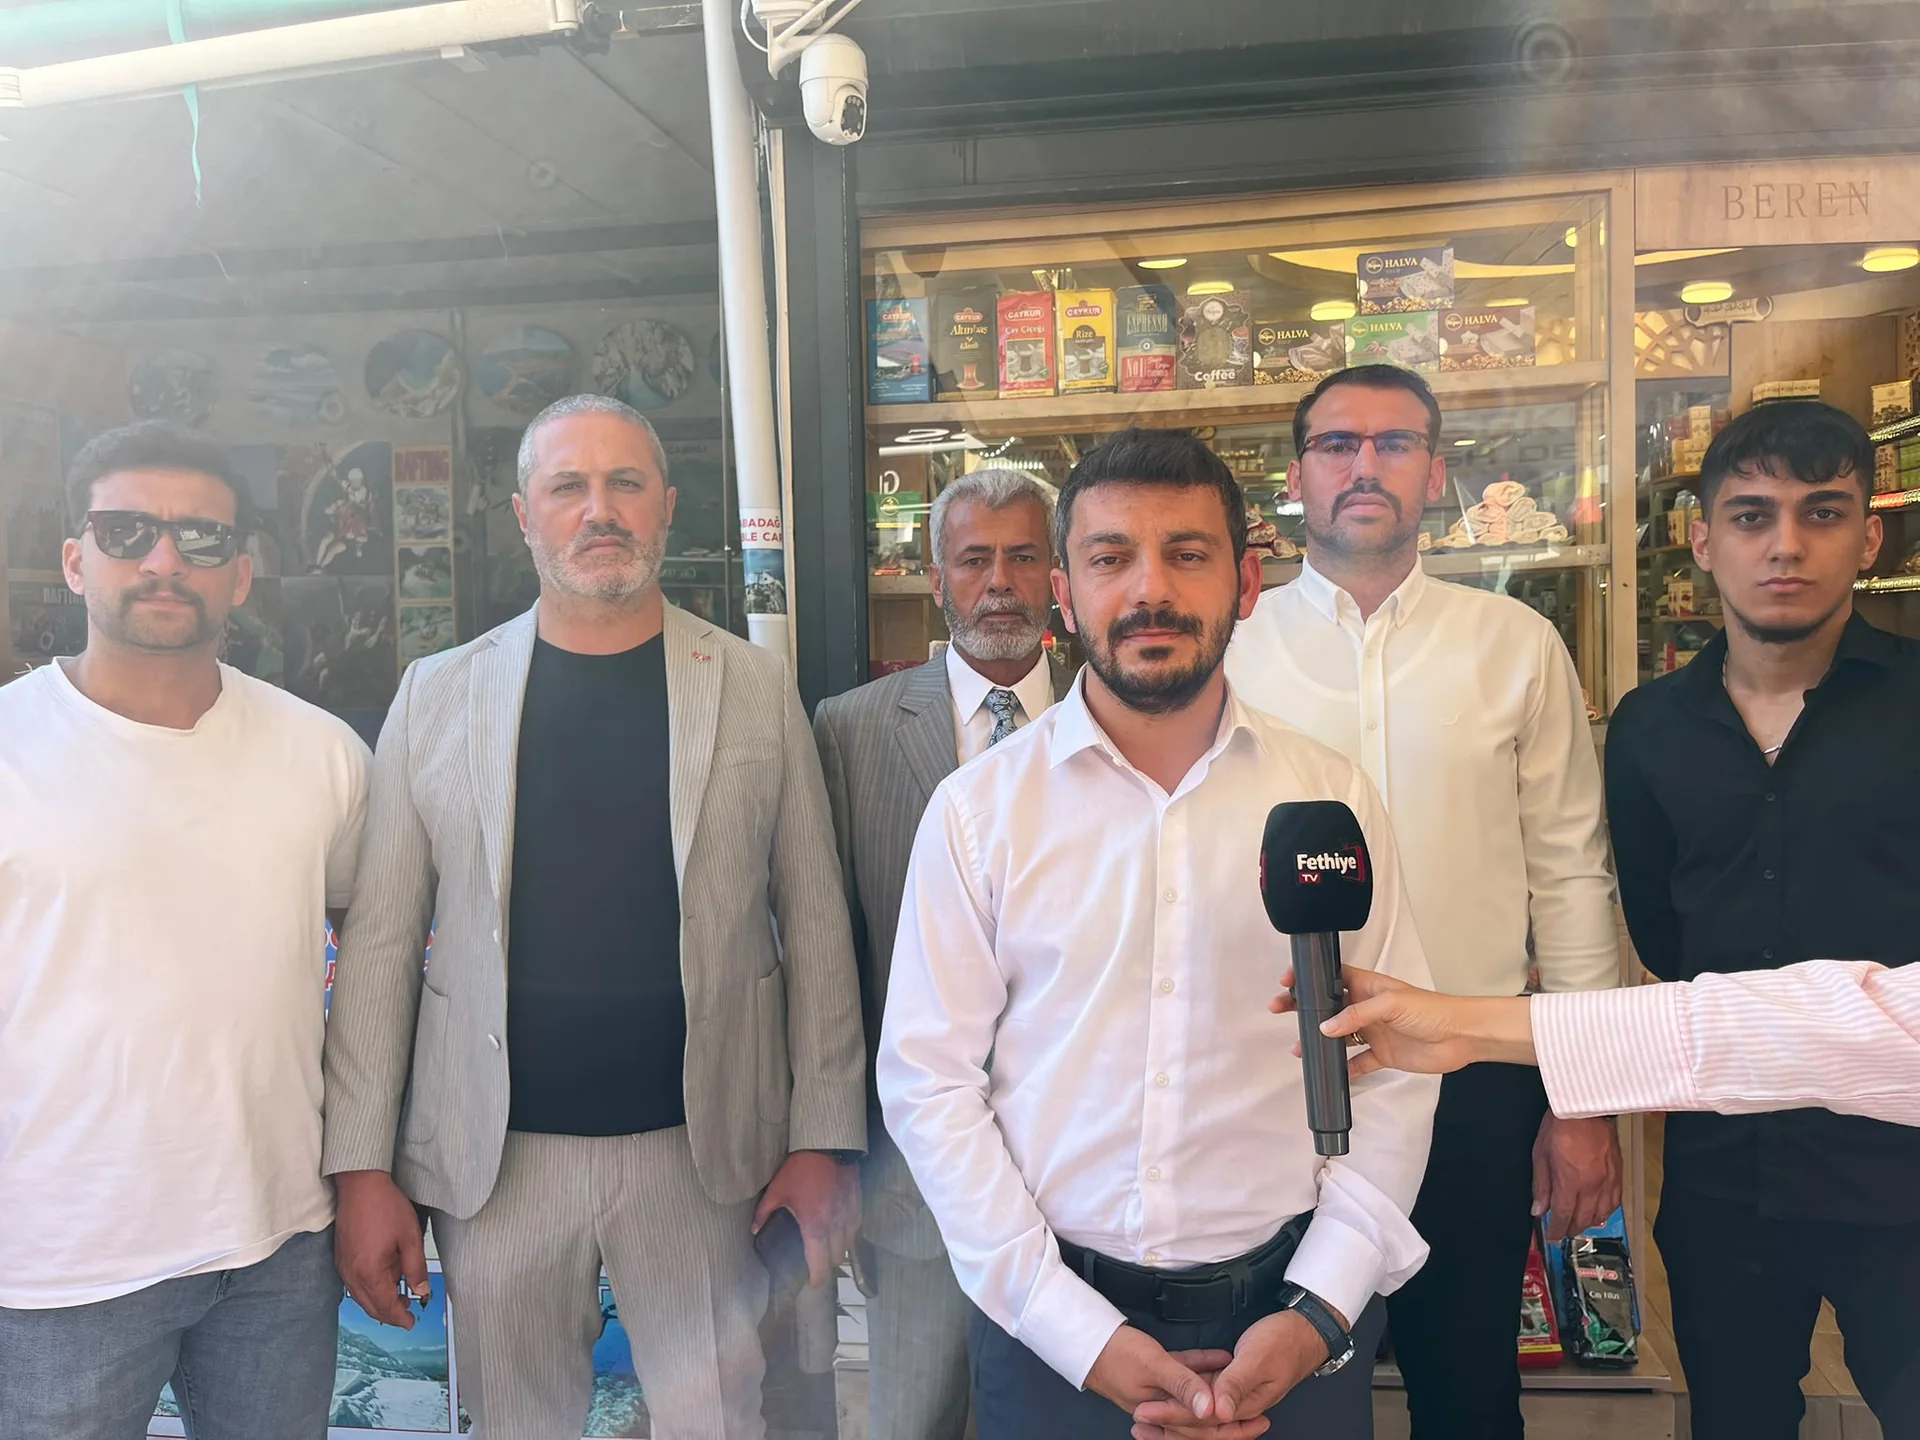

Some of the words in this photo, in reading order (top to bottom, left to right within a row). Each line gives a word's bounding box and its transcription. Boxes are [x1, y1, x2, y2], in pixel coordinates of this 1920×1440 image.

[1722, 180, 1872, 220] BEREN
[1384, 257, 1418, 268] HALVA
[1126, 313, 1168, 335] ESPRESSO
[1464, 314, 1498, 325] HALVA
[1370, 322, 1402, 332] HALVA
[1076, 329, 1094, 339] Rize
[1277, 329, 1309, 340] HALVA
[1194, 368, 1236, 381] Coffee
[741, 516, 780, 528] BADAĞ
[1296, 852, 1357, 875] Fethiye
[1301, 874, 1319, 882] TV
